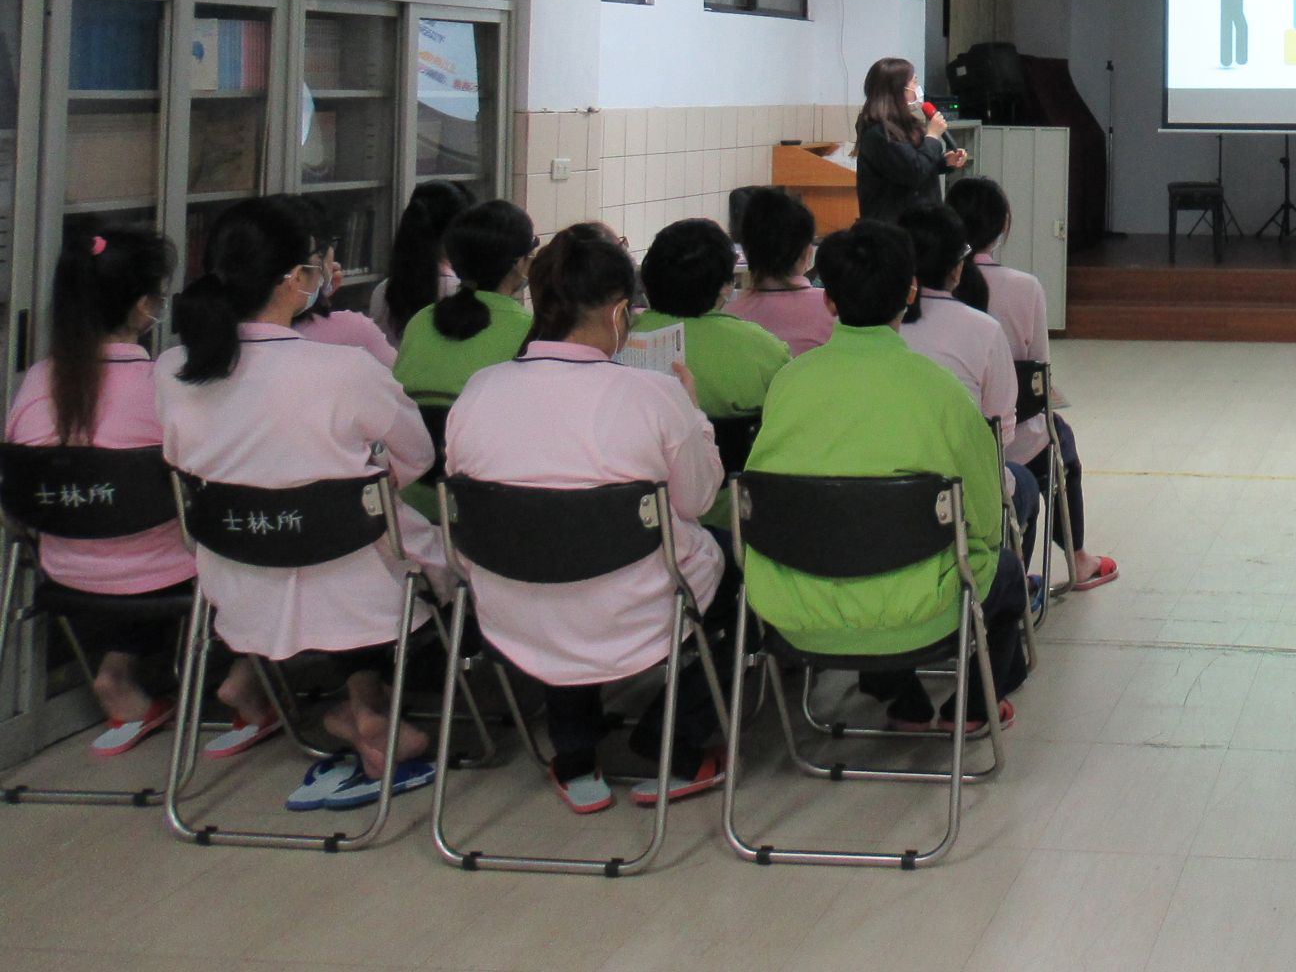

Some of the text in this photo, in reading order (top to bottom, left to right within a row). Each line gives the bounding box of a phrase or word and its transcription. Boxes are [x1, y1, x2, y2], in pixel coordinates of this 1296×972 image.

[36, 483, 116, 507] 士林所
[222, 509, 303, 534] 士林所
